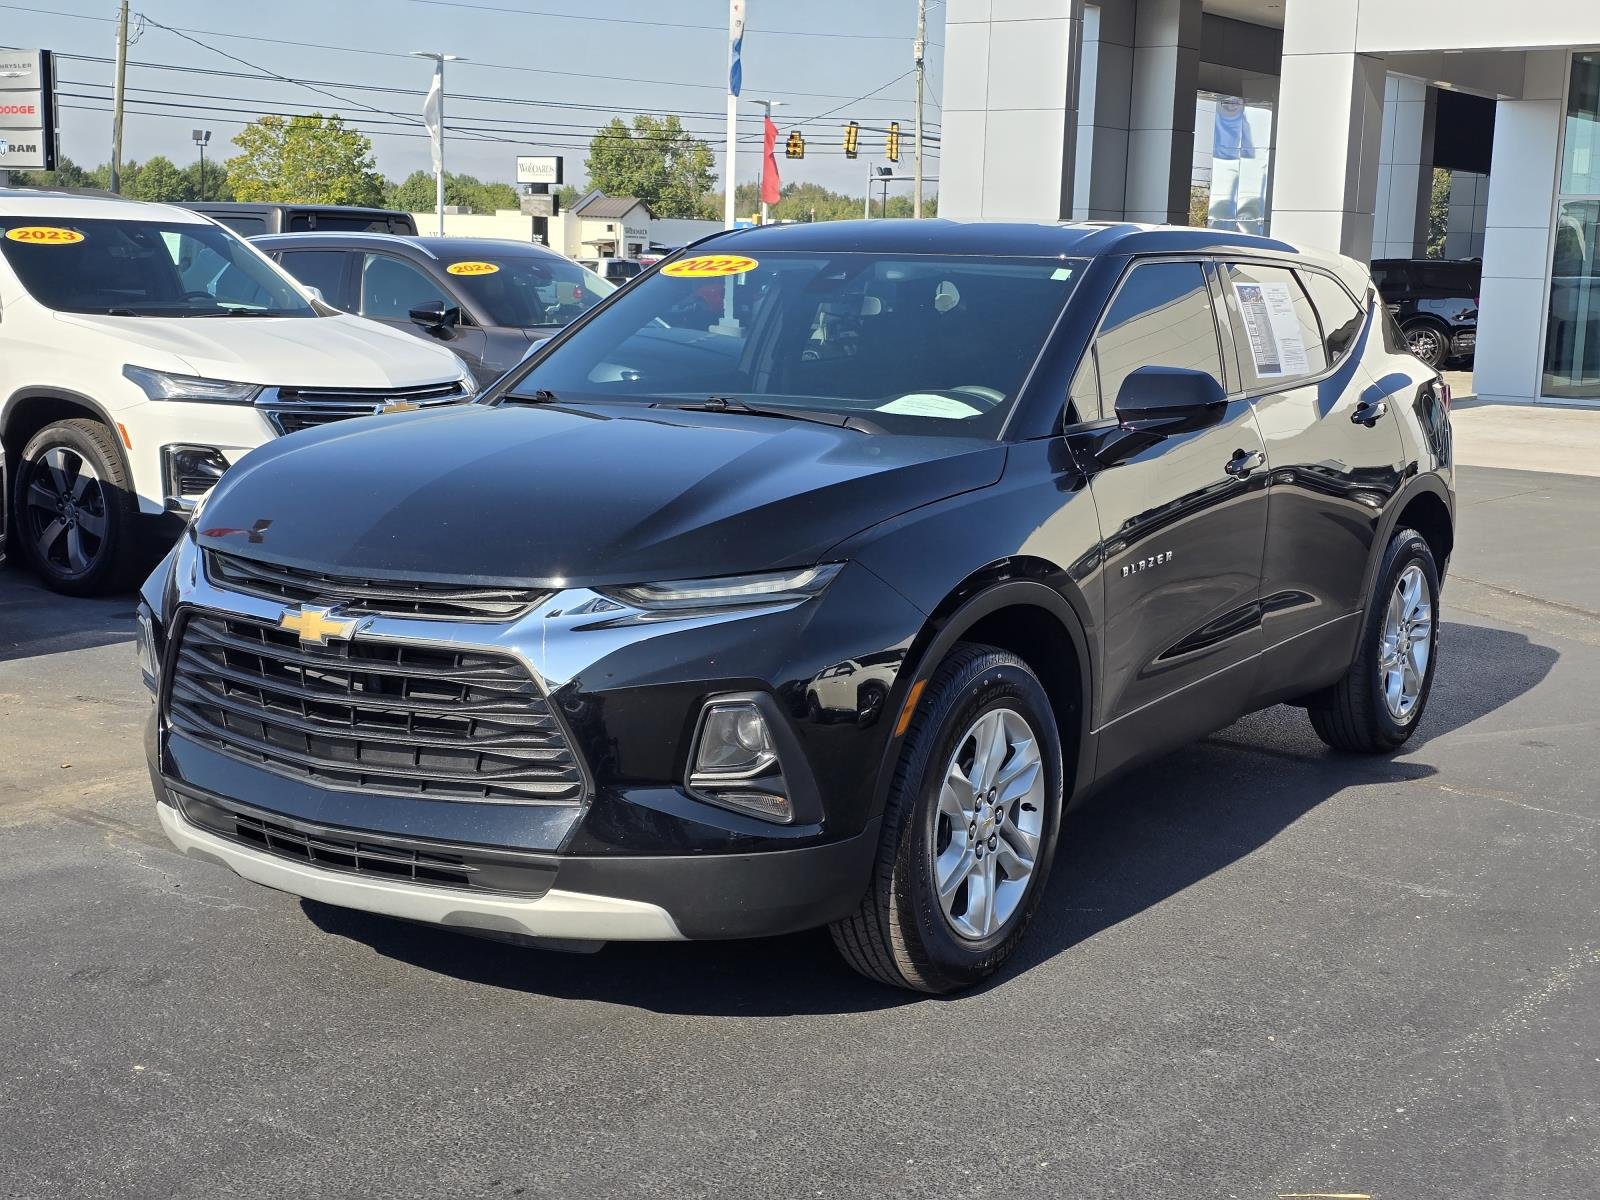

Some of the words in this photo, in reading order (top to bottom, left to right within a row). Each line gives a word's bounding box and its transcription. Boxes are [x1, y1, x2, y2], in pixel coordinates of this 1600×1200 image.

[8, 144, 37, 153] RAM
[17, 230, 76, 240] 2023
[453, 264, 494, 273] 2024
[669, 260, 753, 272] 2022
[1121, 550, 1173, 578] BLAZER
